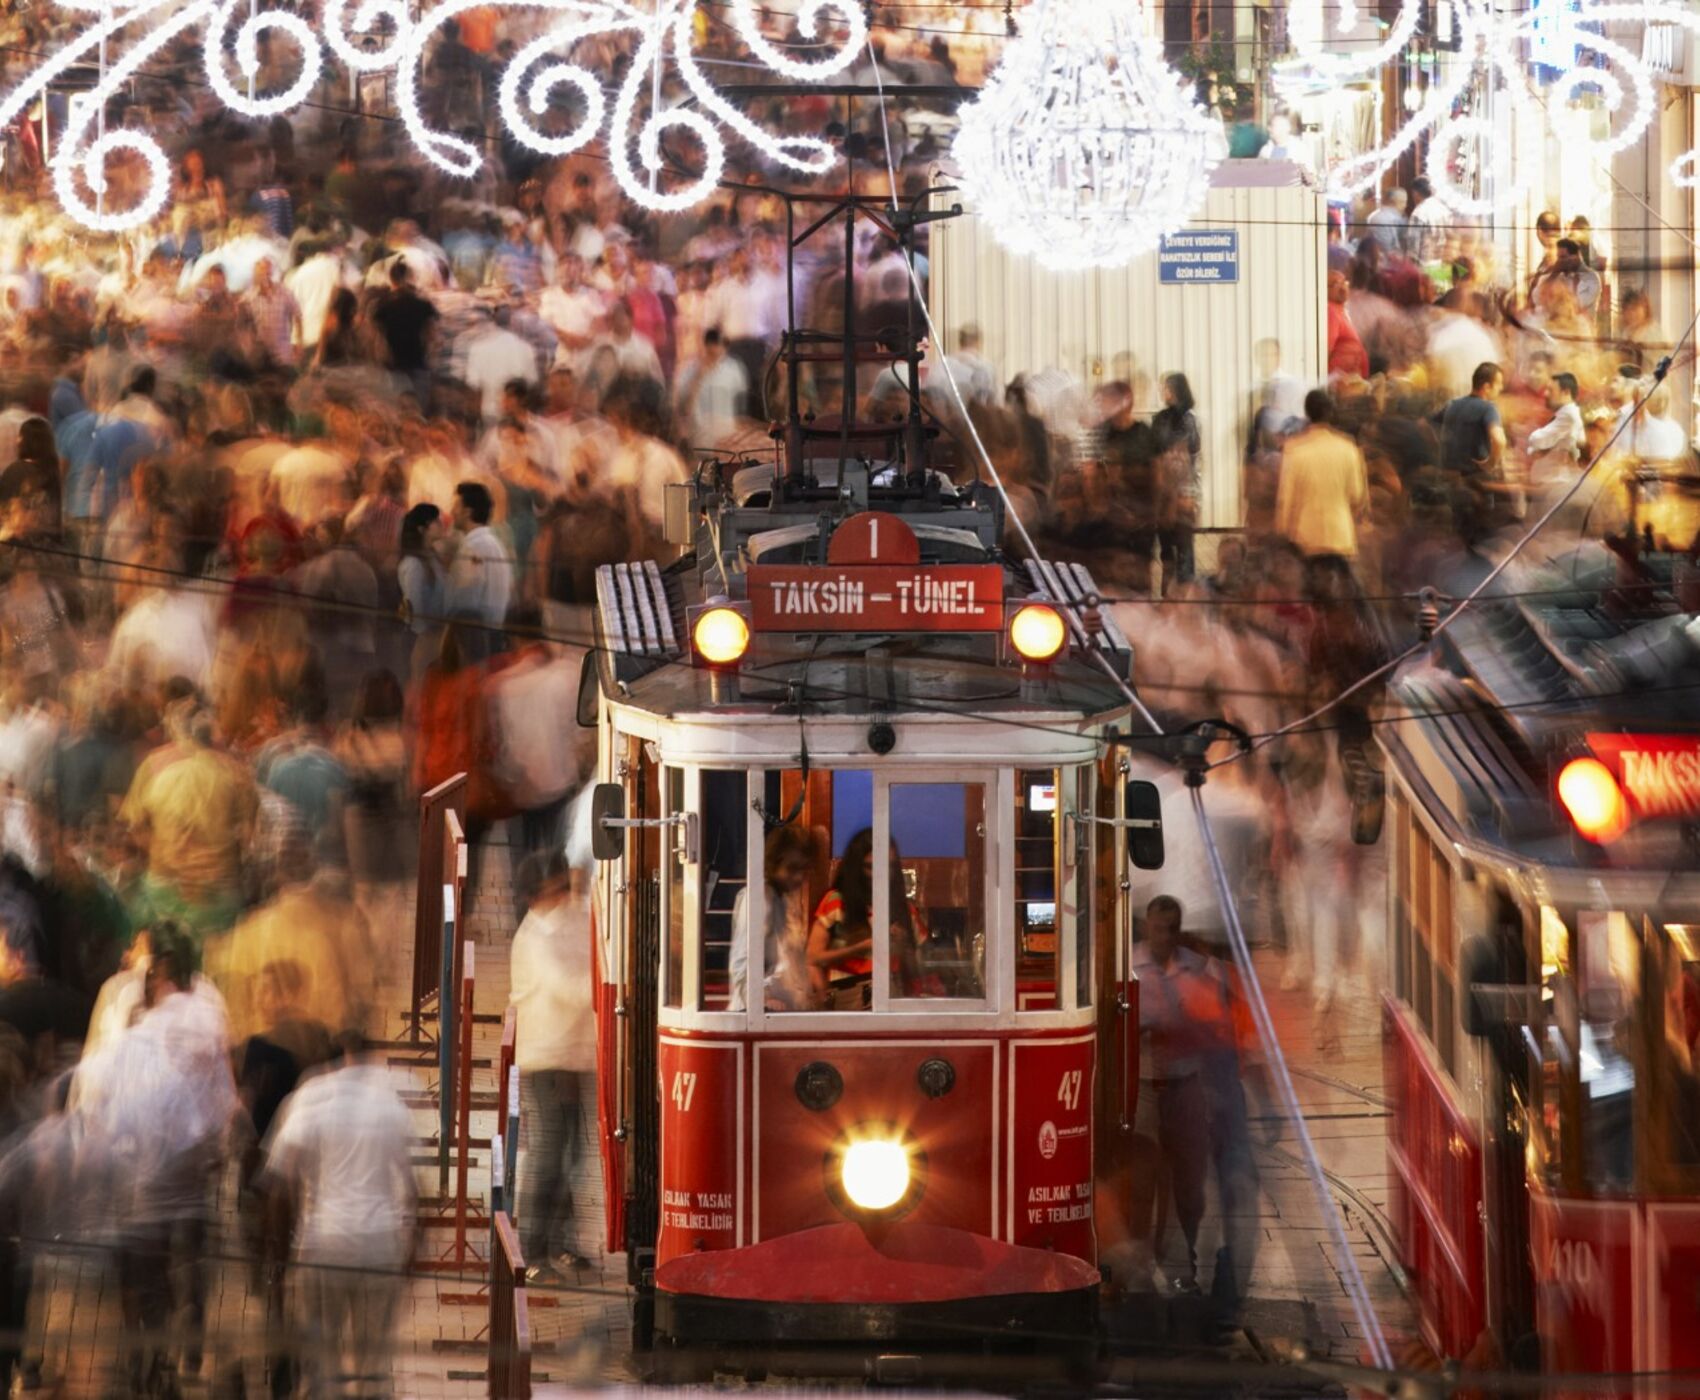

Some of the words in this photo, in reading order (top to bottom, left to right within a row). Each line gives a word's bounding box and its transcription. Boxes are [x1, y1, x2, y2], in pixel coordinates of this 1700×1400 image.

[868, 518, 879, 559] 1
[770, 575, 864, 614] TAKSİM
[896, 575, 985, 614] TÜNEL
[672, 1071, 697, 1111] 47
[1058, 1070, 1082, 1110] 47
[697, 1192, 732, 1208] YASAK
[1028, 1185, 1071, 1202] ASILMAK
[1028, 1209, 1042, 1224] VE
